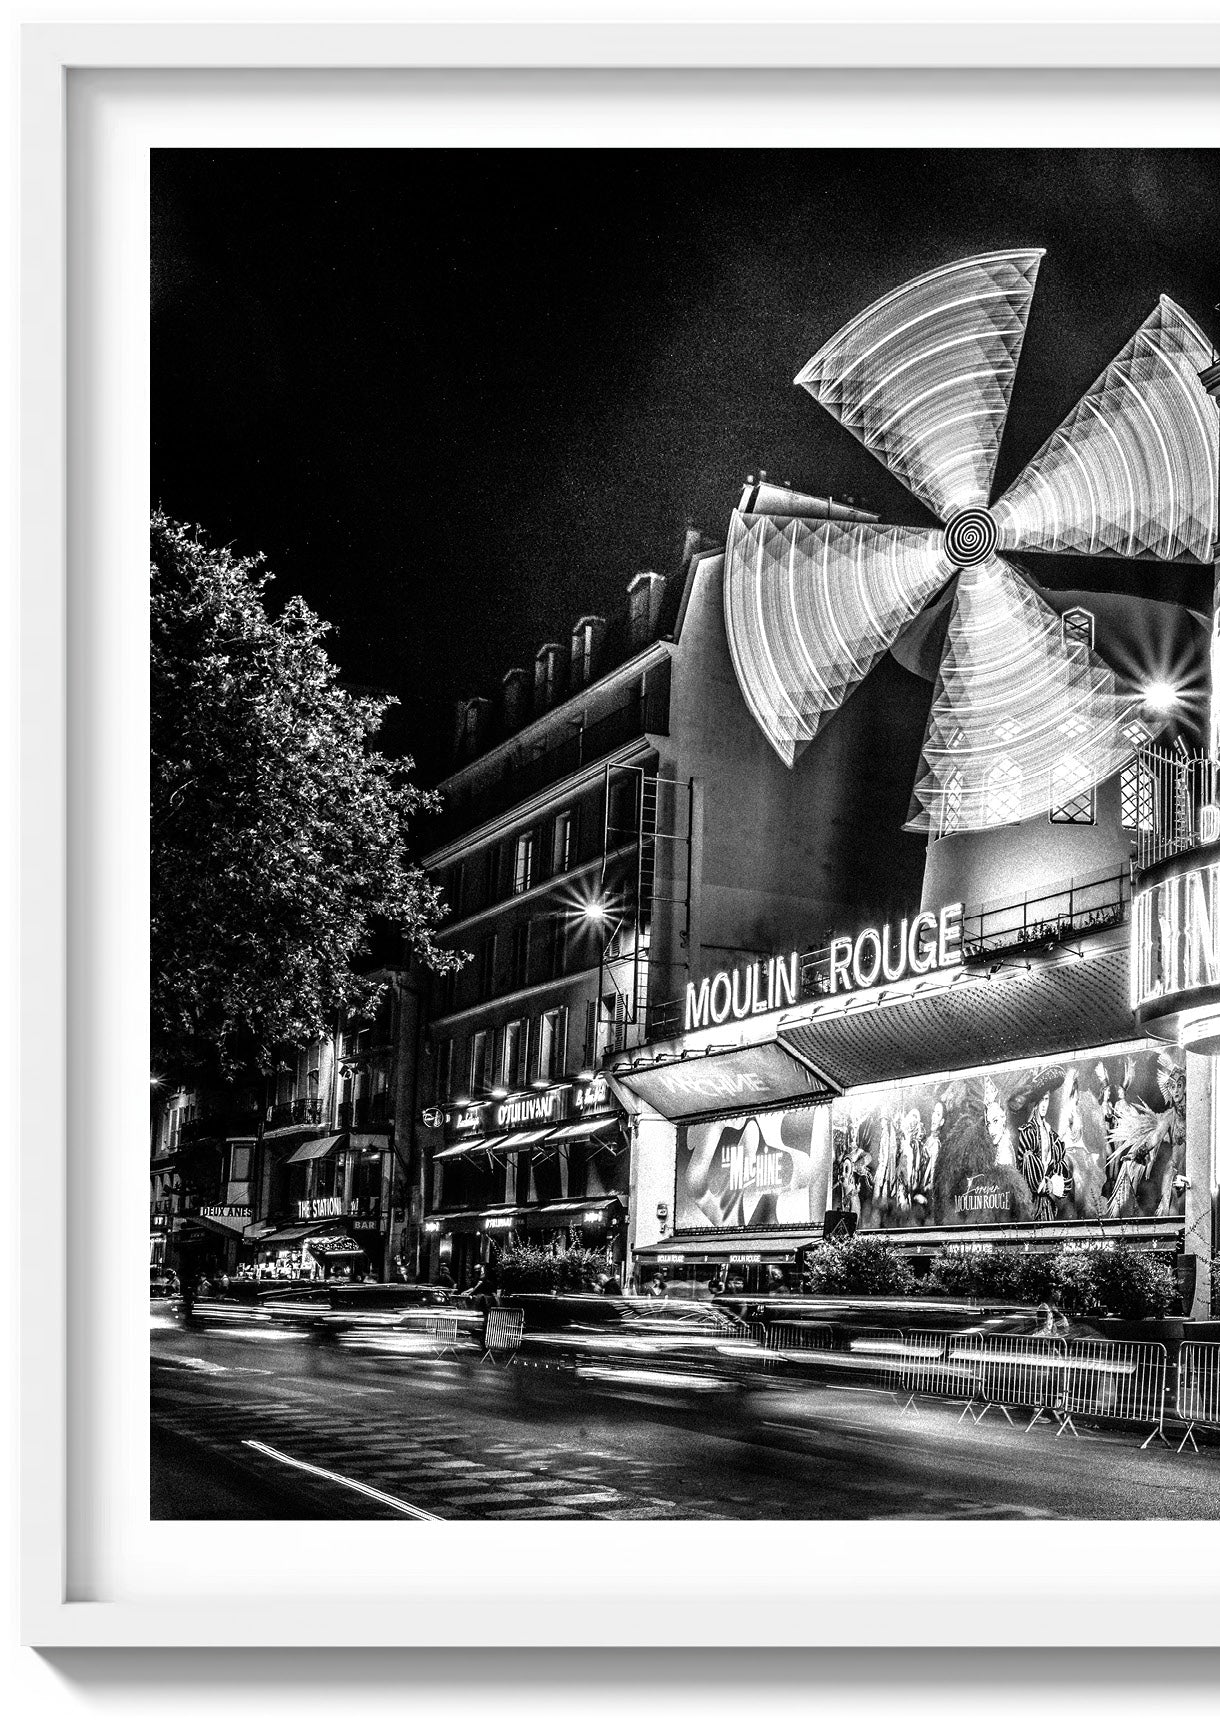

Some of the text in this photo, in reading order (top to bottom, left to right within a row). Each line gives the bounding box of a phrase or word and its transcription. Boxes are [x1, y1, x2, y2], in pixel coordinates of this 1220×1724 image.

[684, 903, 966, 1030] MOULIN ROUGE
[202, 1207, 225, 1217] DEUX
[312, 1197, 341, 1218] STATION
[954, 1191, 1010, 1213] MOULIN ROUGE
[354, 1221, 376, 1230] BAR
